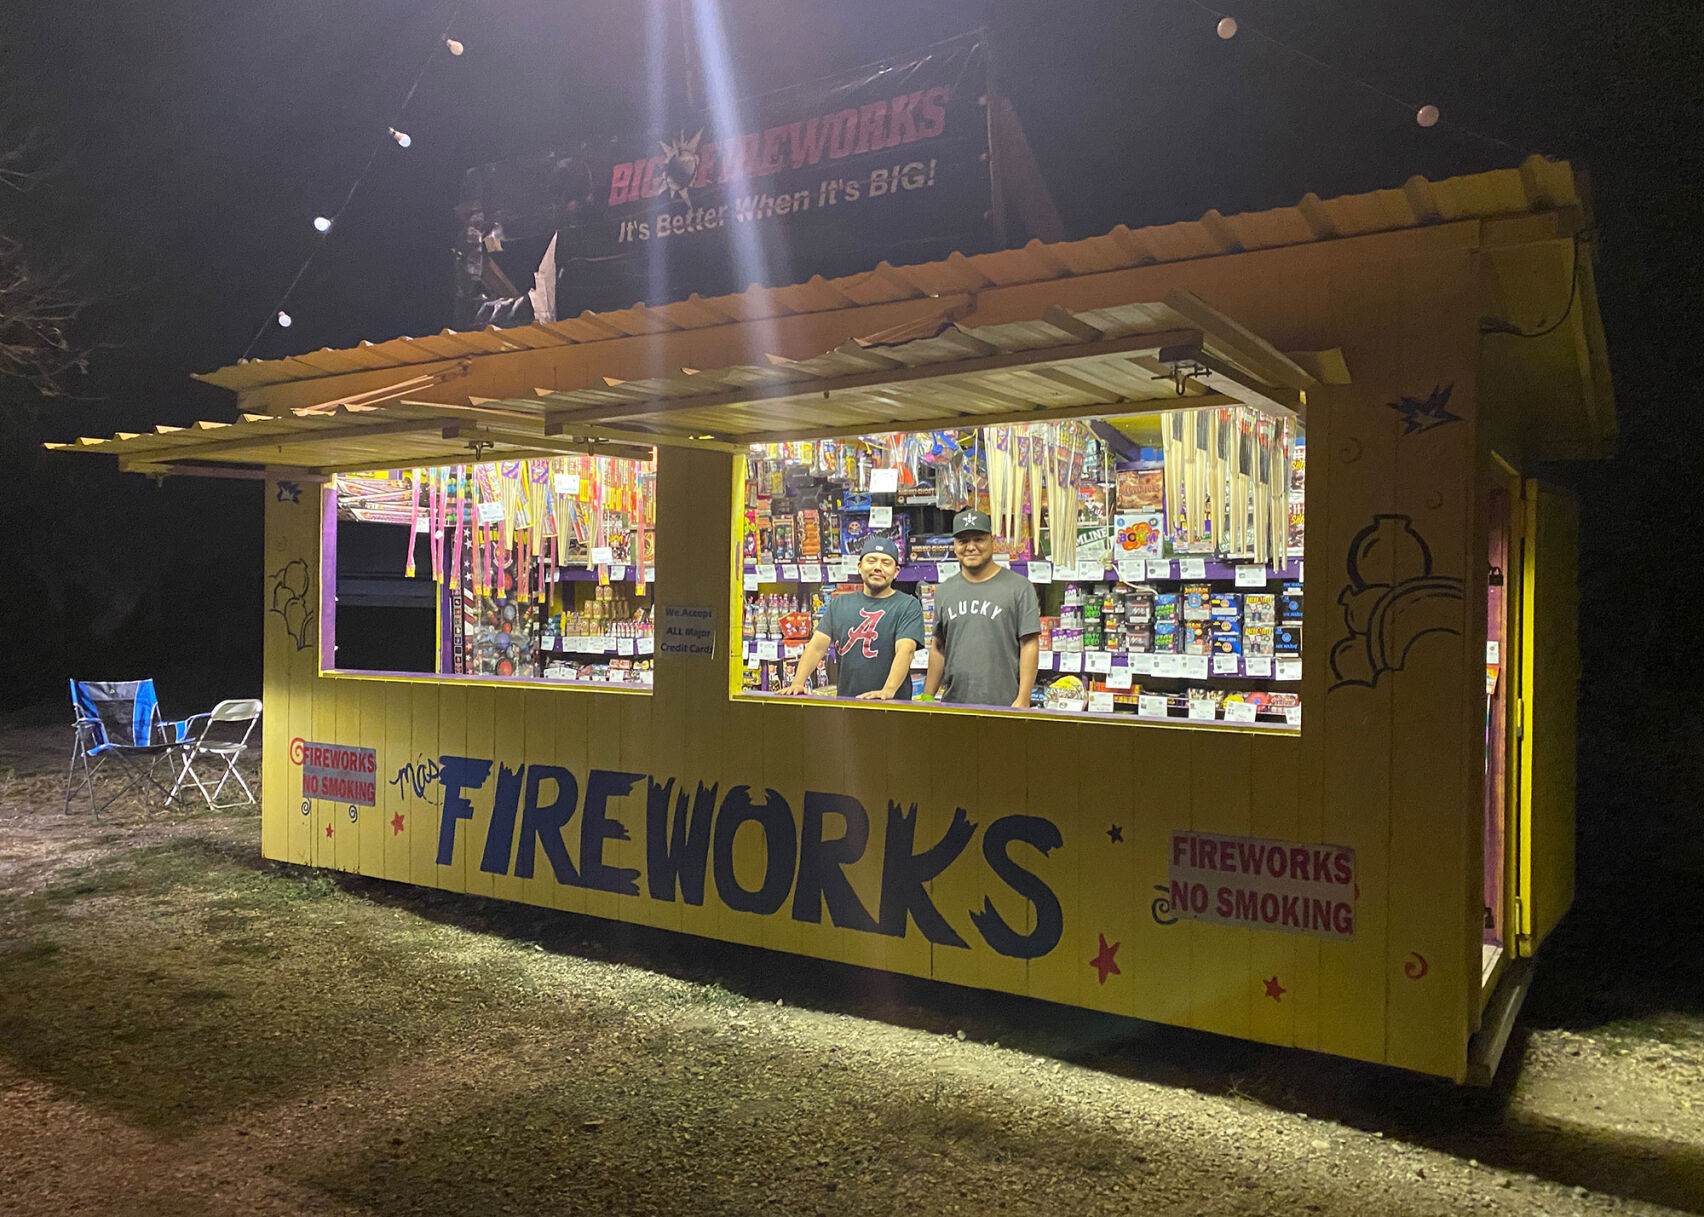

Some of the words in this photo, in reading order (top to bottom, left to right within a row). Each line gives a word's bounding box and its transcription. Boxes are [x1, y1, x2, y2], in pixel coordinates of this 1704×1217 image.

[618, 220, 651, 243] It's
[656, 205, 728, 238] Better
[735, 190, 810, 223] When
[818, 178, 861, 207] It's
[869, 159, 937, 197] BIG!
[665, 608, 680, 616] We
[682, 609, 712, 619] Accept
[948, 600, 1002, 620] LUCKY
[661, 643, 687, 652] Credit
[666, 627, 683, 636] ALL
[685, 628, 711, 639] Major
[834, 607, 886, 659] A
[303, 747, 375, 774] FIREWORKS
[303, 774, 319, 795] NO
[322, 776, 375, 804] SMOKING
[436, 755, 1064, 960] FIREWORKS
[1172, 836, 1353, 885] FIREWORKS
[1171, 880, 1209, 914] NO
[1216, 887, 1353, 935] SMOKING
